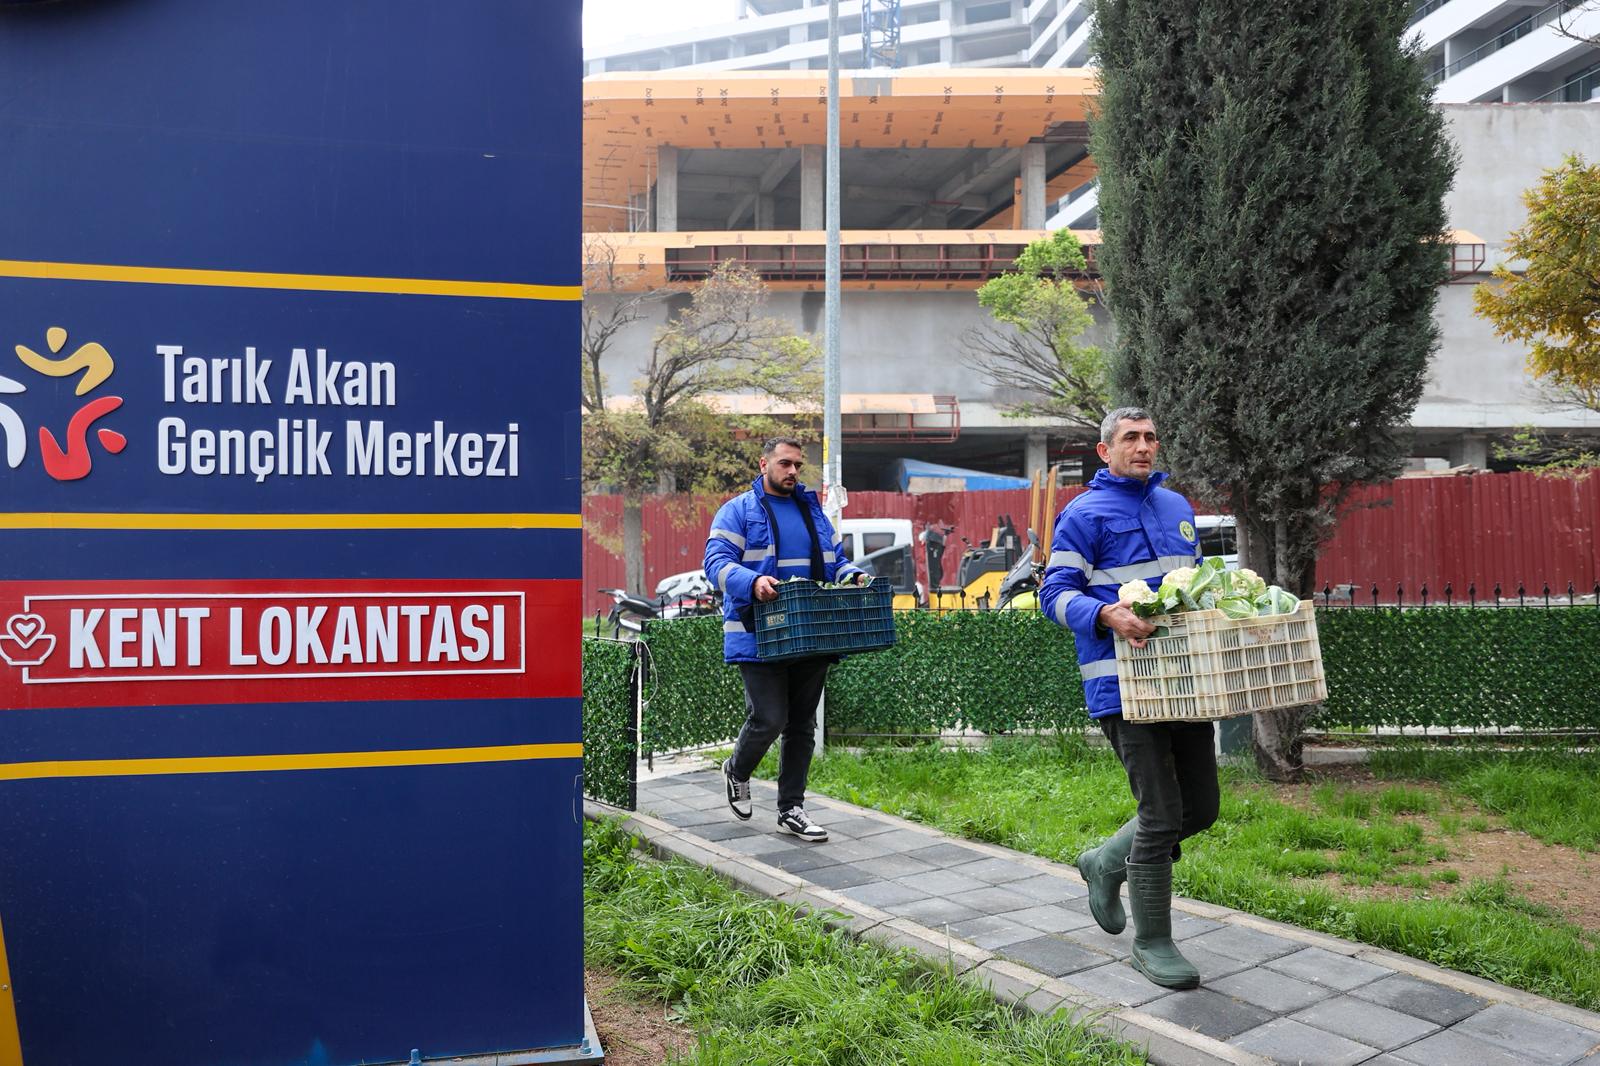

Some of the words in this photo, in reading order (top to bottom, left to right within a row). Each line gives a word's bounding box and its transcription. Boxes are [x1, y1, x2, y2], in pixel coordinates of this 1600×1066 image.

[156, 344, 273, 404] Tarık
[285, 347, 396, 406] Akan
[157, 416, 333, 483] Gençlik
[346, 419, 519, 477] Merkezi
[69, 607, 210, 669] KENT
[229, 604, 505, 666] LOKANTASI
